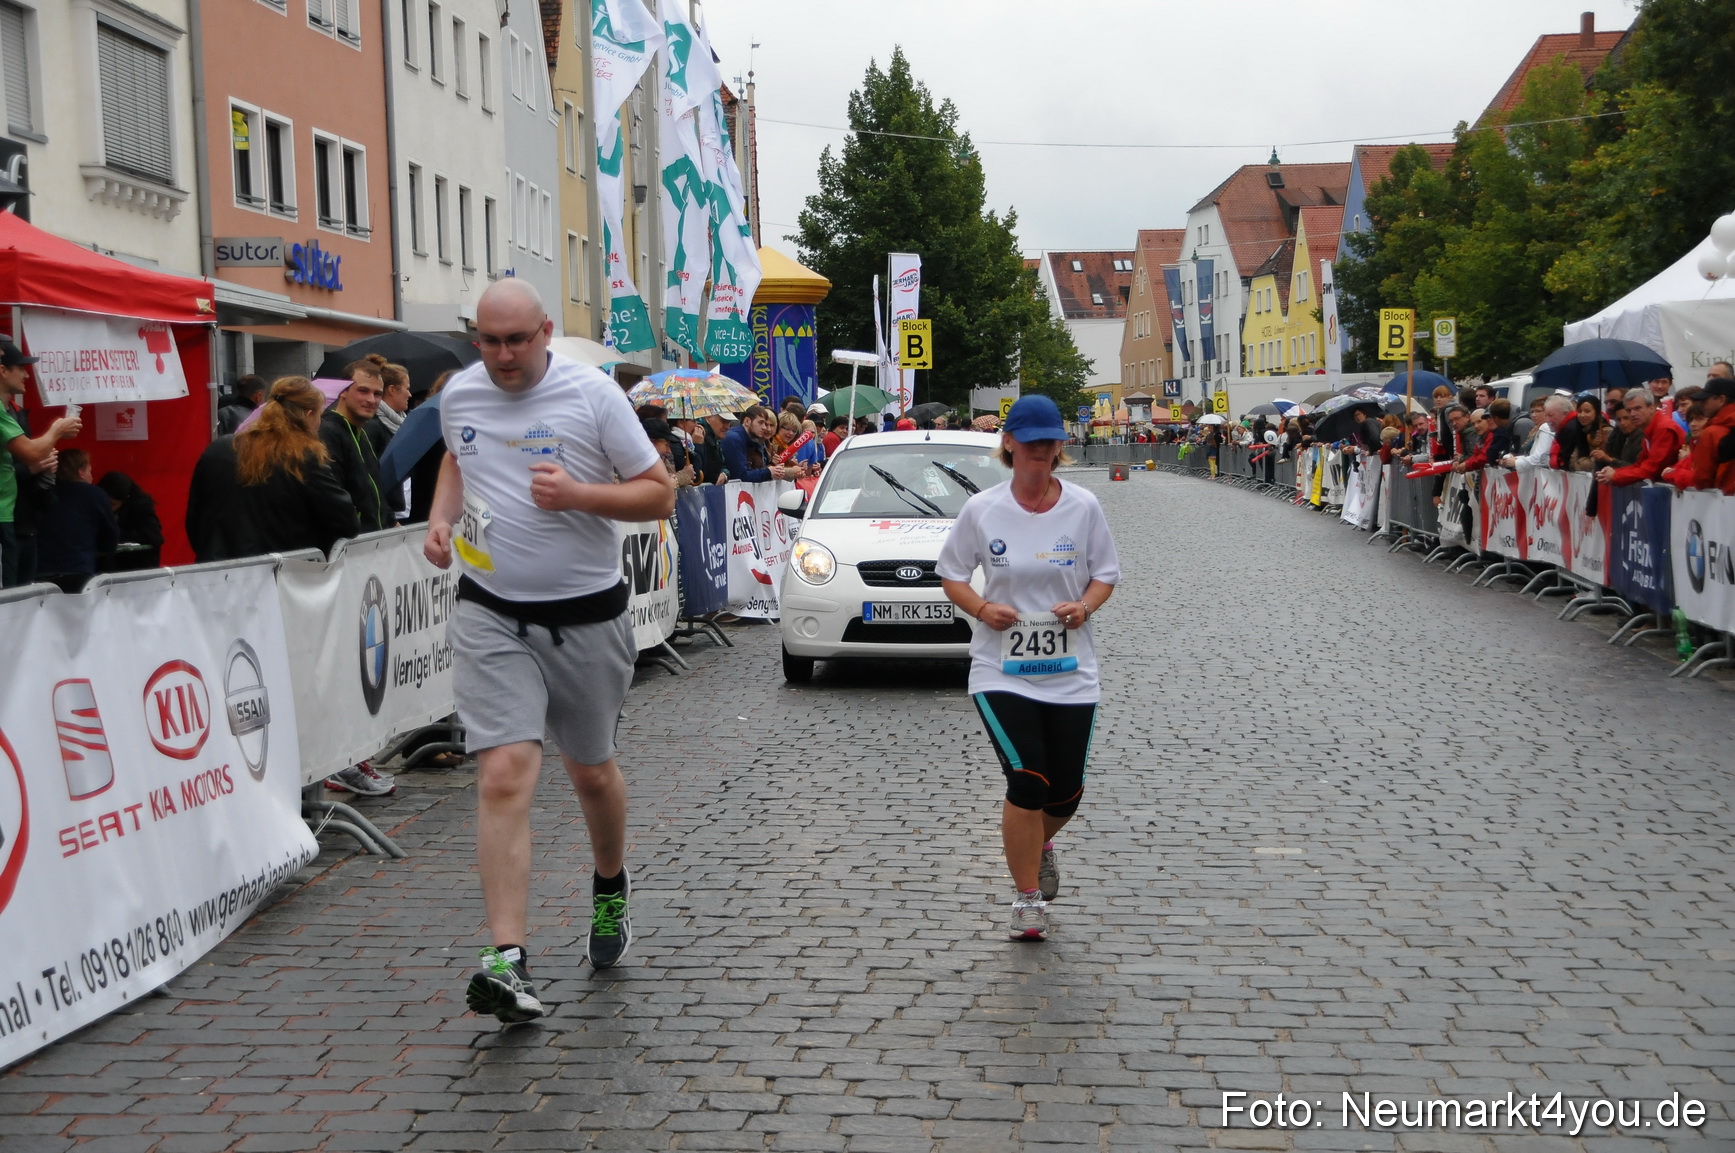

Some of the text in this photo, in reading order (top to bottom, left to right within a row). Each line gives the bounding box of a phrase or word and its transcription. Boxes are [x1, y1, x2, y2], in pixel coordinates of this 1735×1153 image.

[618, 52, 643, 63] GmbH
[216, 242, 279, 261] sutor.
[1384, 311, 1410, 320] Block
[902, 322, 928, 331] Block
[1388, 324, 1405, 348] B
[907, 334, 924, 359] B
[1216, 398, 1224, 409] C
[1173, 409, 1179, 418] D
[900, 569, 918, 577] KIA
[394, 579, 429, 639] BMW
[873, 604, 952, 619] NM RK 153
[1010, 628, 1067, 657] 2431
[1018, 662, 1063, 673] Adelheid
[154, 683, 205, 740] KIA
[149, 763, 234, 822] KIA MOTORS
[59, 802, 143, 859] SEAT
[42, 961, 82, 1012] Tel.
[81, 925, 156, 994] 09181/26
